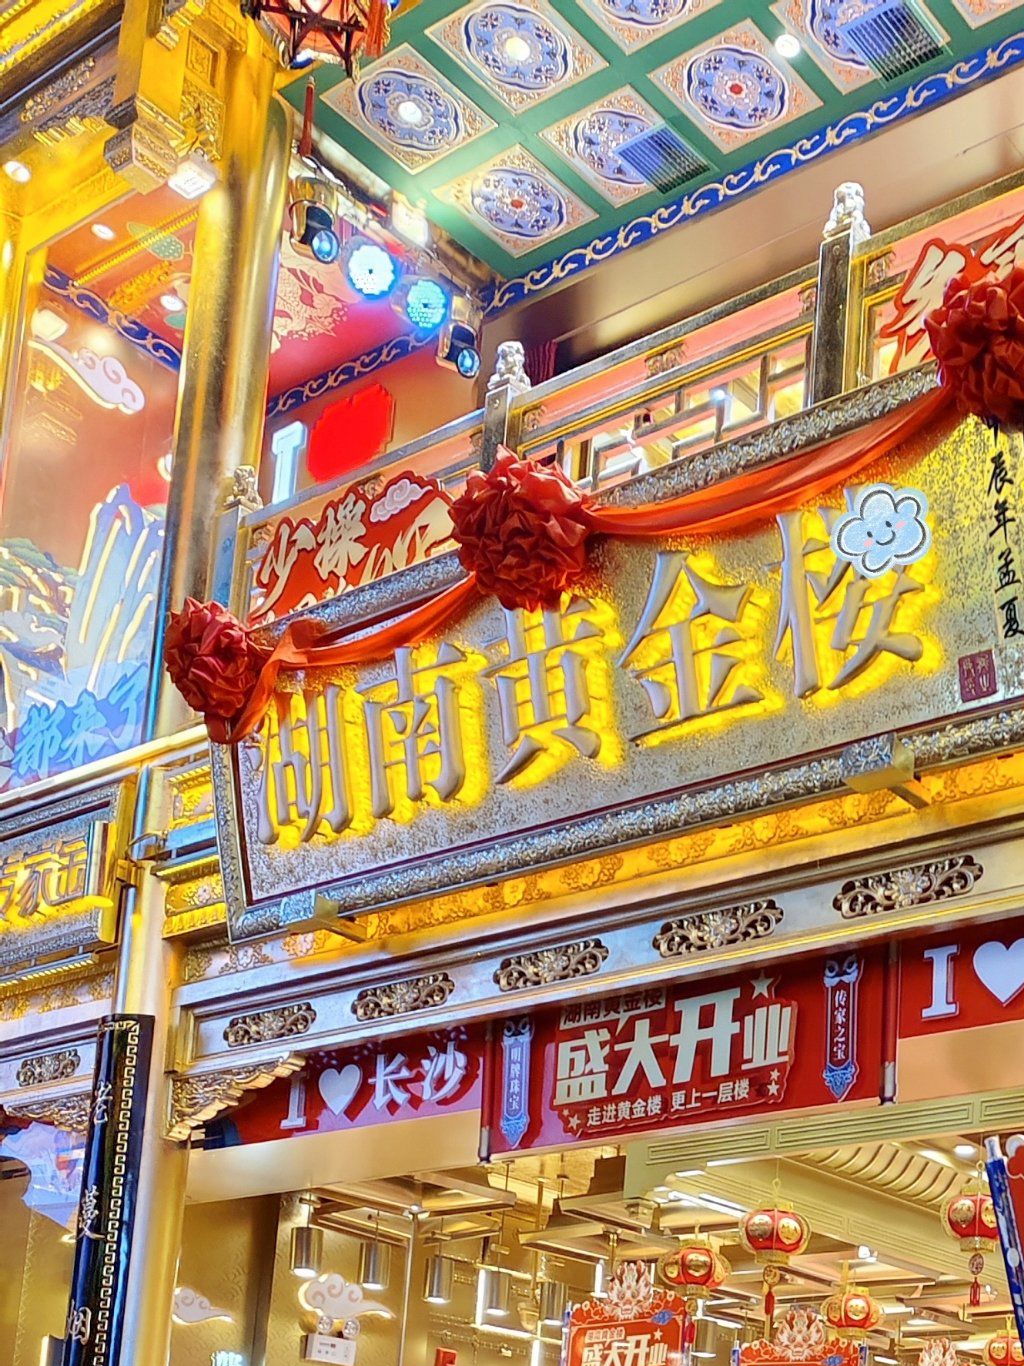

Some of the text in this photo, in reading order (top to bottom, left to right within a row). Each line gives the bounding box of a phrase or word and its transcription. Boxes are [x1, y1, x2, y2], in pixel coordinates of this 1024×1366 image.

[257, 484, 926, 846] 湖南黄金楼
[563, 986, 665, 1027] 湖南黄金楼
[921, 944, 960, 1021] I
[553, 987, 793, 1106] 盛大开业
[834, 989, 848, 1061] 传家之宝
[368, 1040, 469, 1110] 长沙
[587, 1078, 750, 1128] 走进黄金楼 更上一层楼
